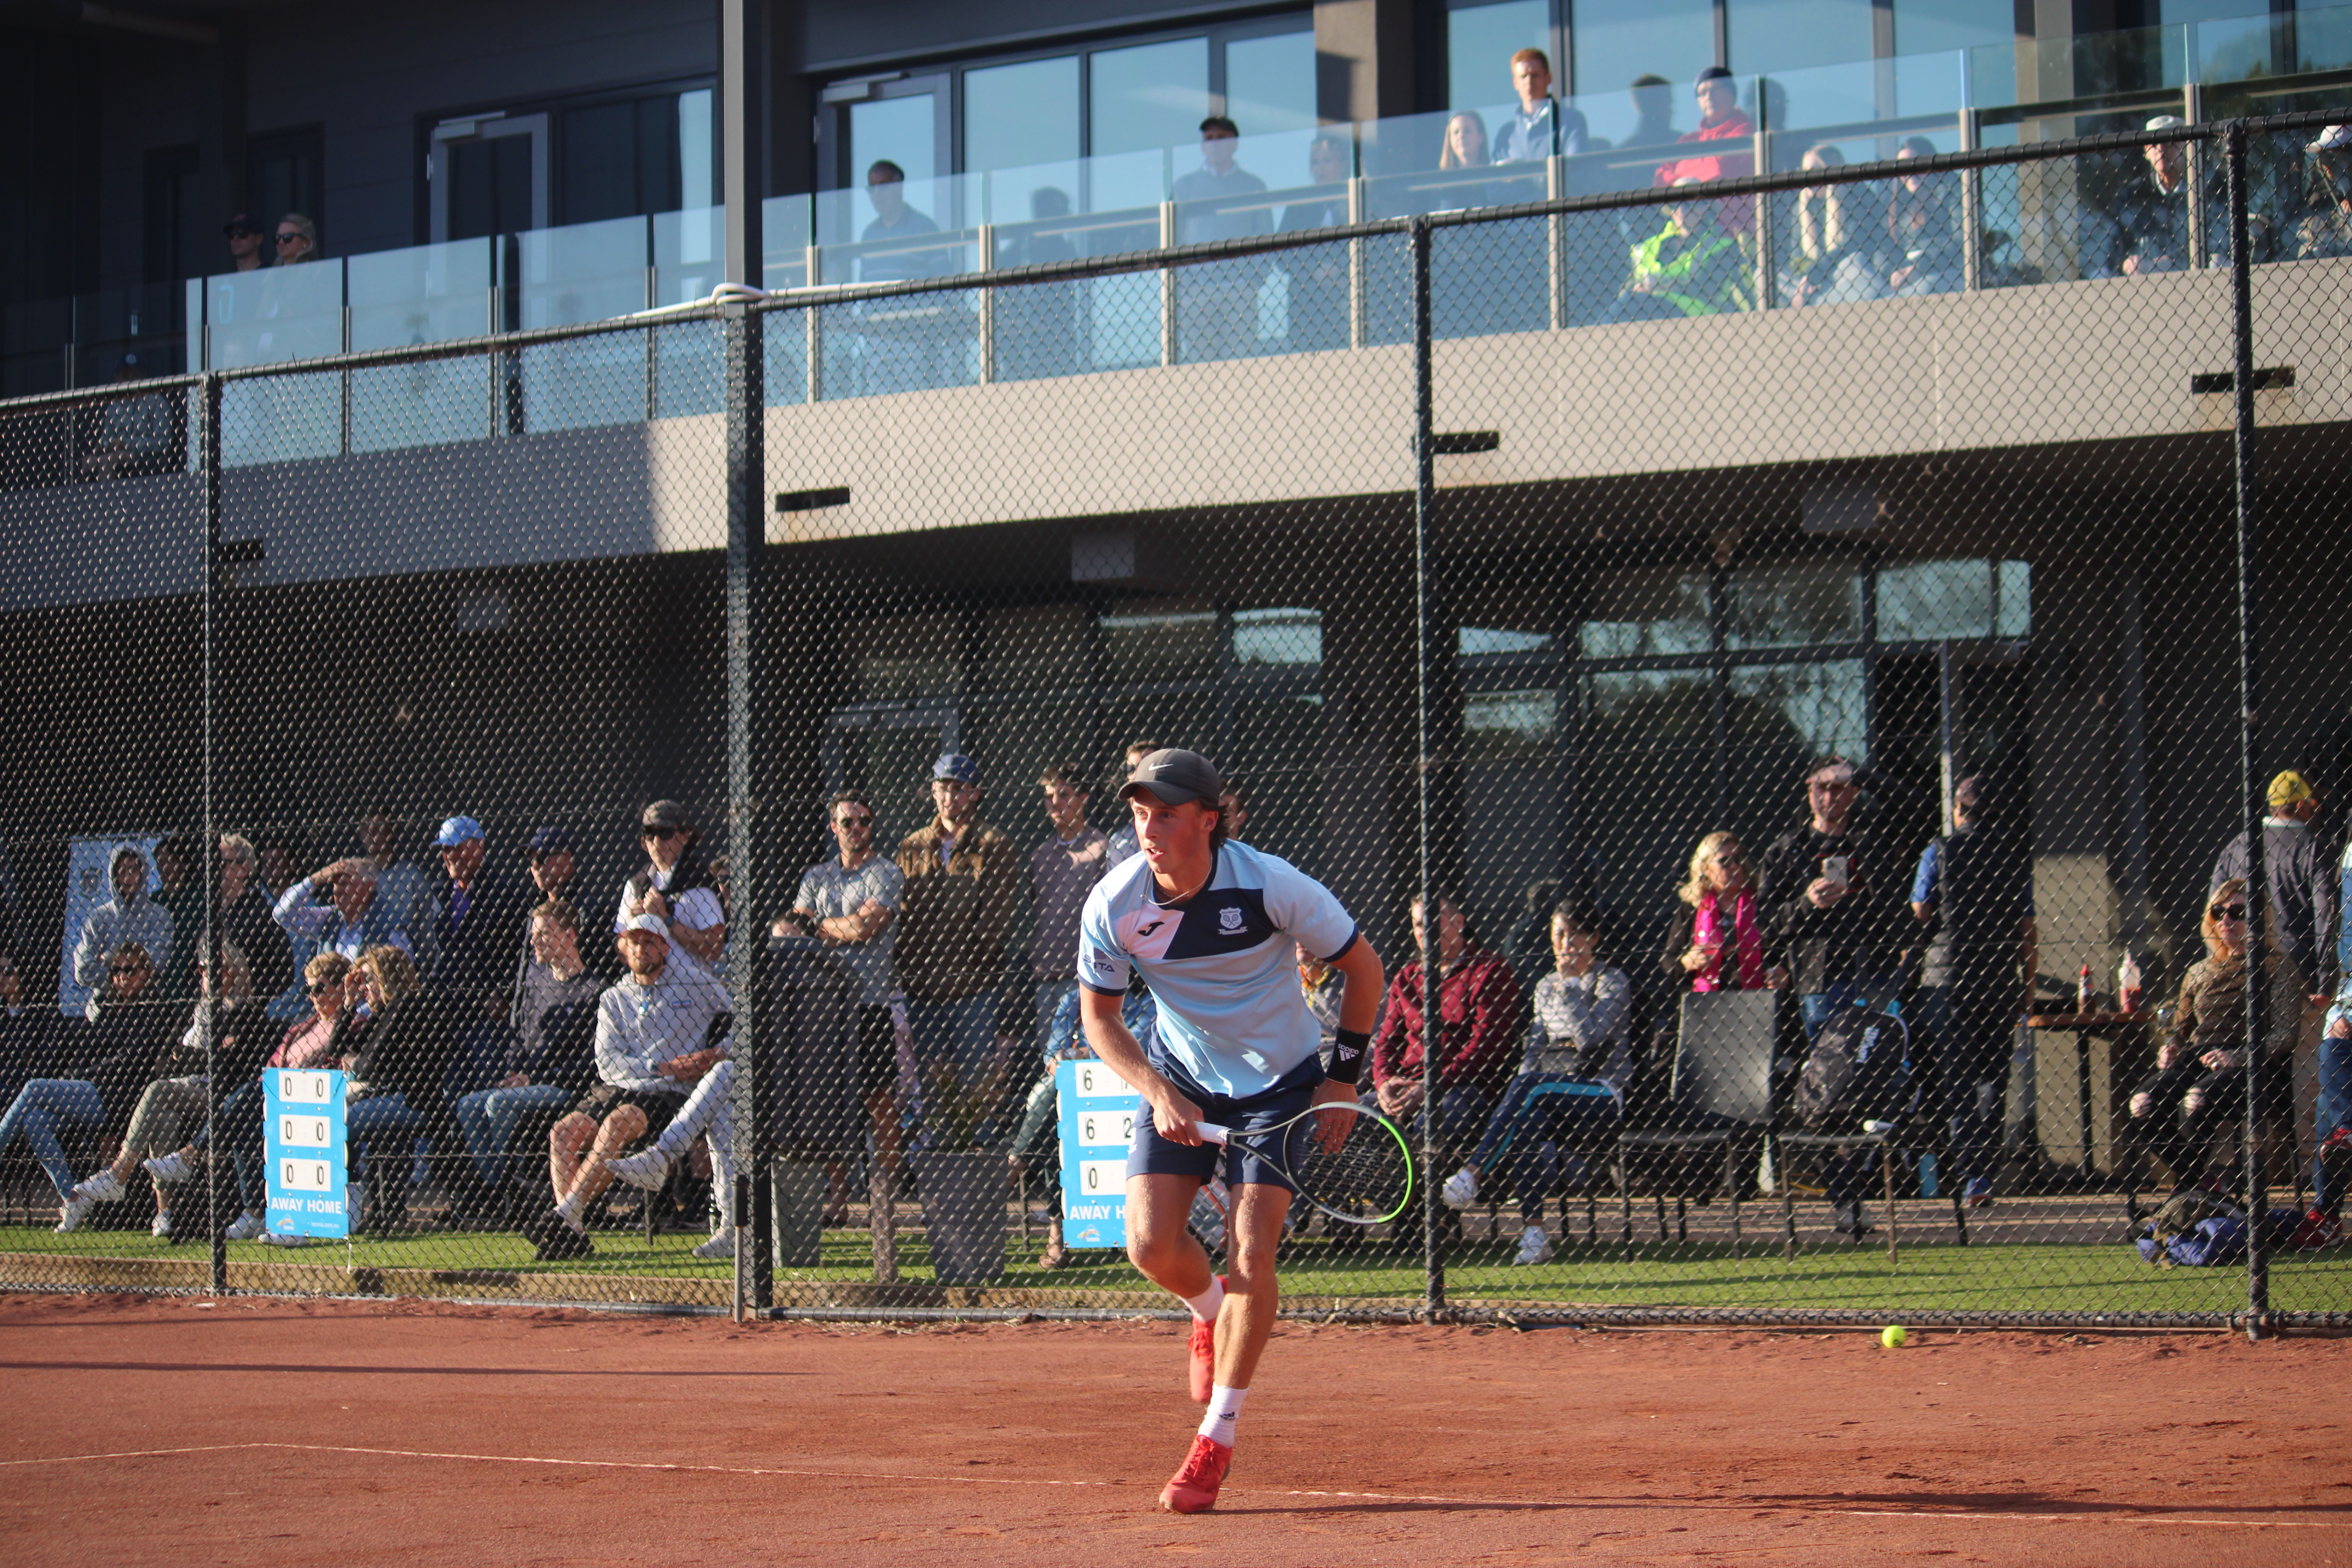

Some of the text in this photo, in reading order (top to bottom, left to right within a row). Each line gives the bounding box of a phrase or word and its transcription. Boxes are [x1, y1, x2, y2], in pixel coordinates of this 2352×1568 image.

[1338, 1044, 1359, 1054] adidas
[285, 1076, 324, 1098] 0 0
[1084, 1069, 1093, 1091] 6
[285, 1120, 324, 1142] 0 0
[1087, 1117, 1132, 1140] 6 2
[287, 1164, 324, 1185] 0 0
[1089, 1167, 1098, 1189] 0
[270, 1197, 342, 1214] AWAY HOME
[1069, 1205, 1111, 1220] AWAY
